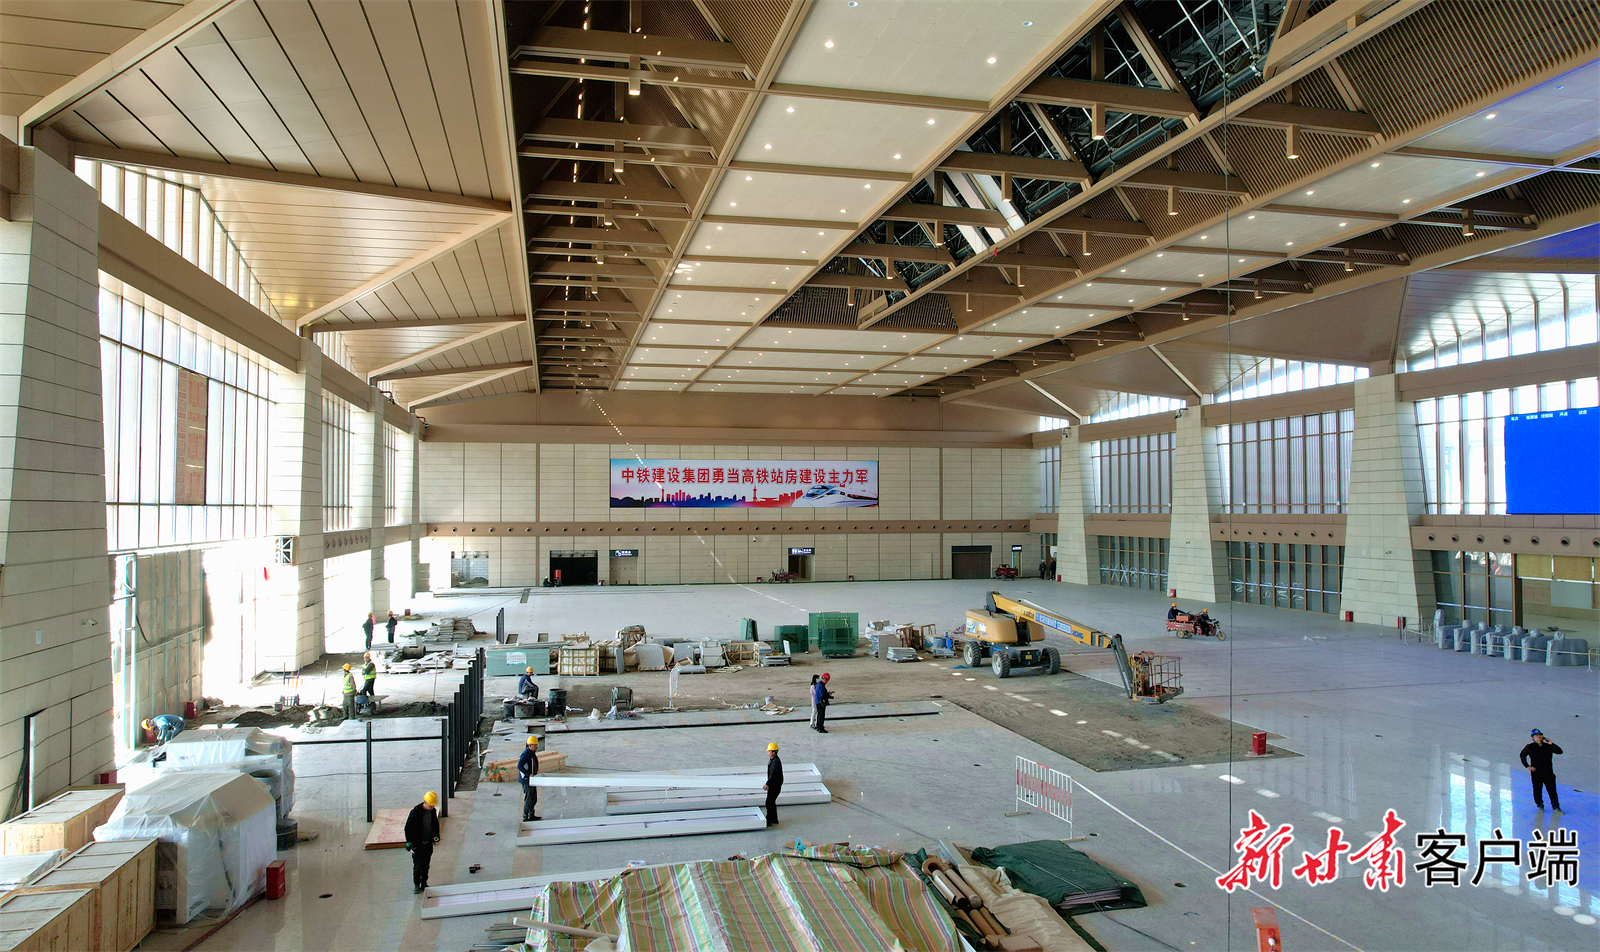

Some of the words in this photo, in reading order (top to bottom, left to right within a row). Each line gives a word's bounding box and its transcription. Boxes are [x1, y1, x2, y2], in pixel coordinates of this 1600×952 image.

[620, 466, 869, 485] 中铁建设集团勇当高铁站房建设主力军
